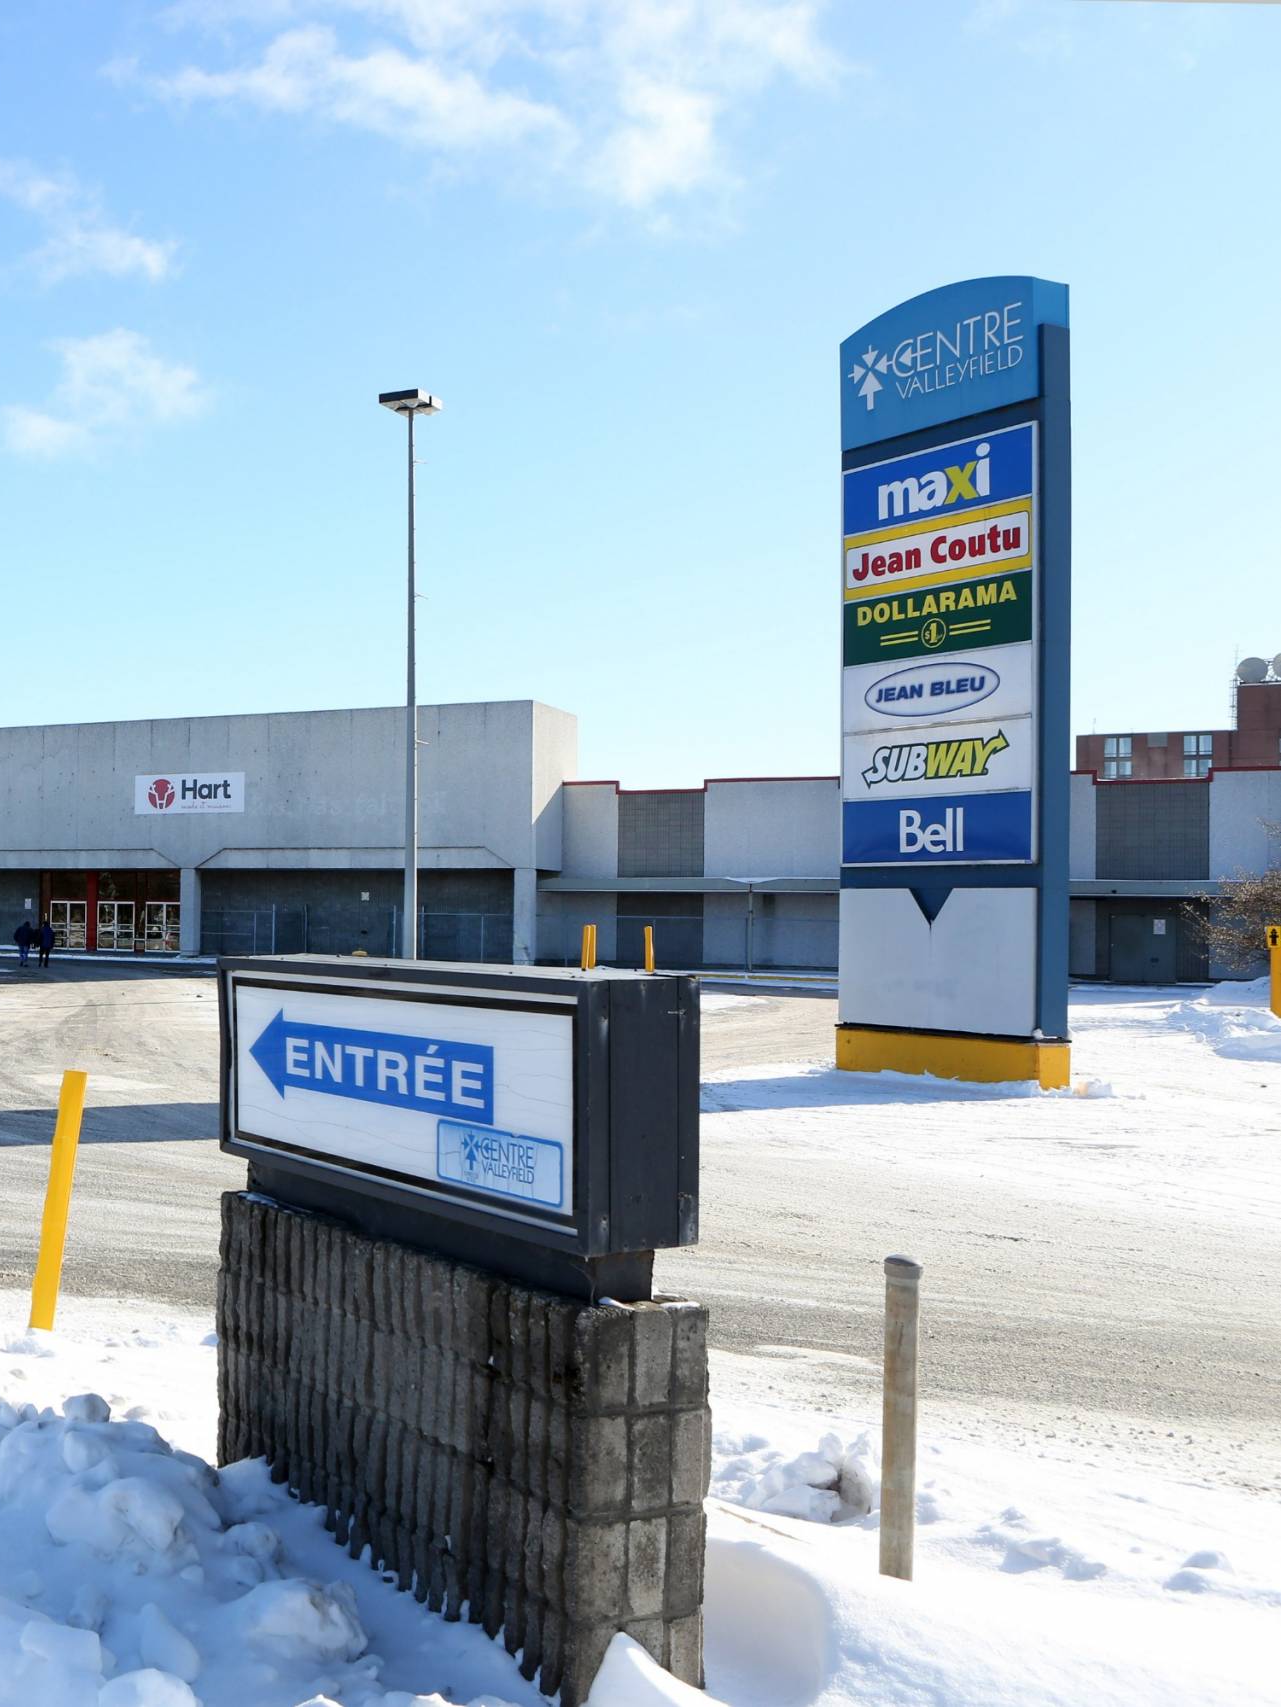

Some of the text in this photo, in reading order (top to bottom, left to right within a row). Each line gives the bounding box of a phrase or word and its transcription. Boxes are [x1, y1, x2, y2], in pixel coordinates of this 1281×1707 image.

[892, 302, 1024, 377] CENTRE
[895, 345, 1024, 399] VALLEYFIELD
[878, 442, 991, 521] maxi
[852, 524, 1021, 581] Jean Coutu
[857, 580, 1017, 627] DOLLARAMA
[876, 676, 986, 703] JEAN BLEU
[862, 730, 1009, 788] SUBWAY
[181, 779, 231, 800] Hart
[899, 807, 965, 854] Bell
[285, 1037, 485, 1108] ENTRÉE
[480, 1137, 535, 1170] CENTRE
[481, 1160, 535, 1185] VALLEYFIELD
